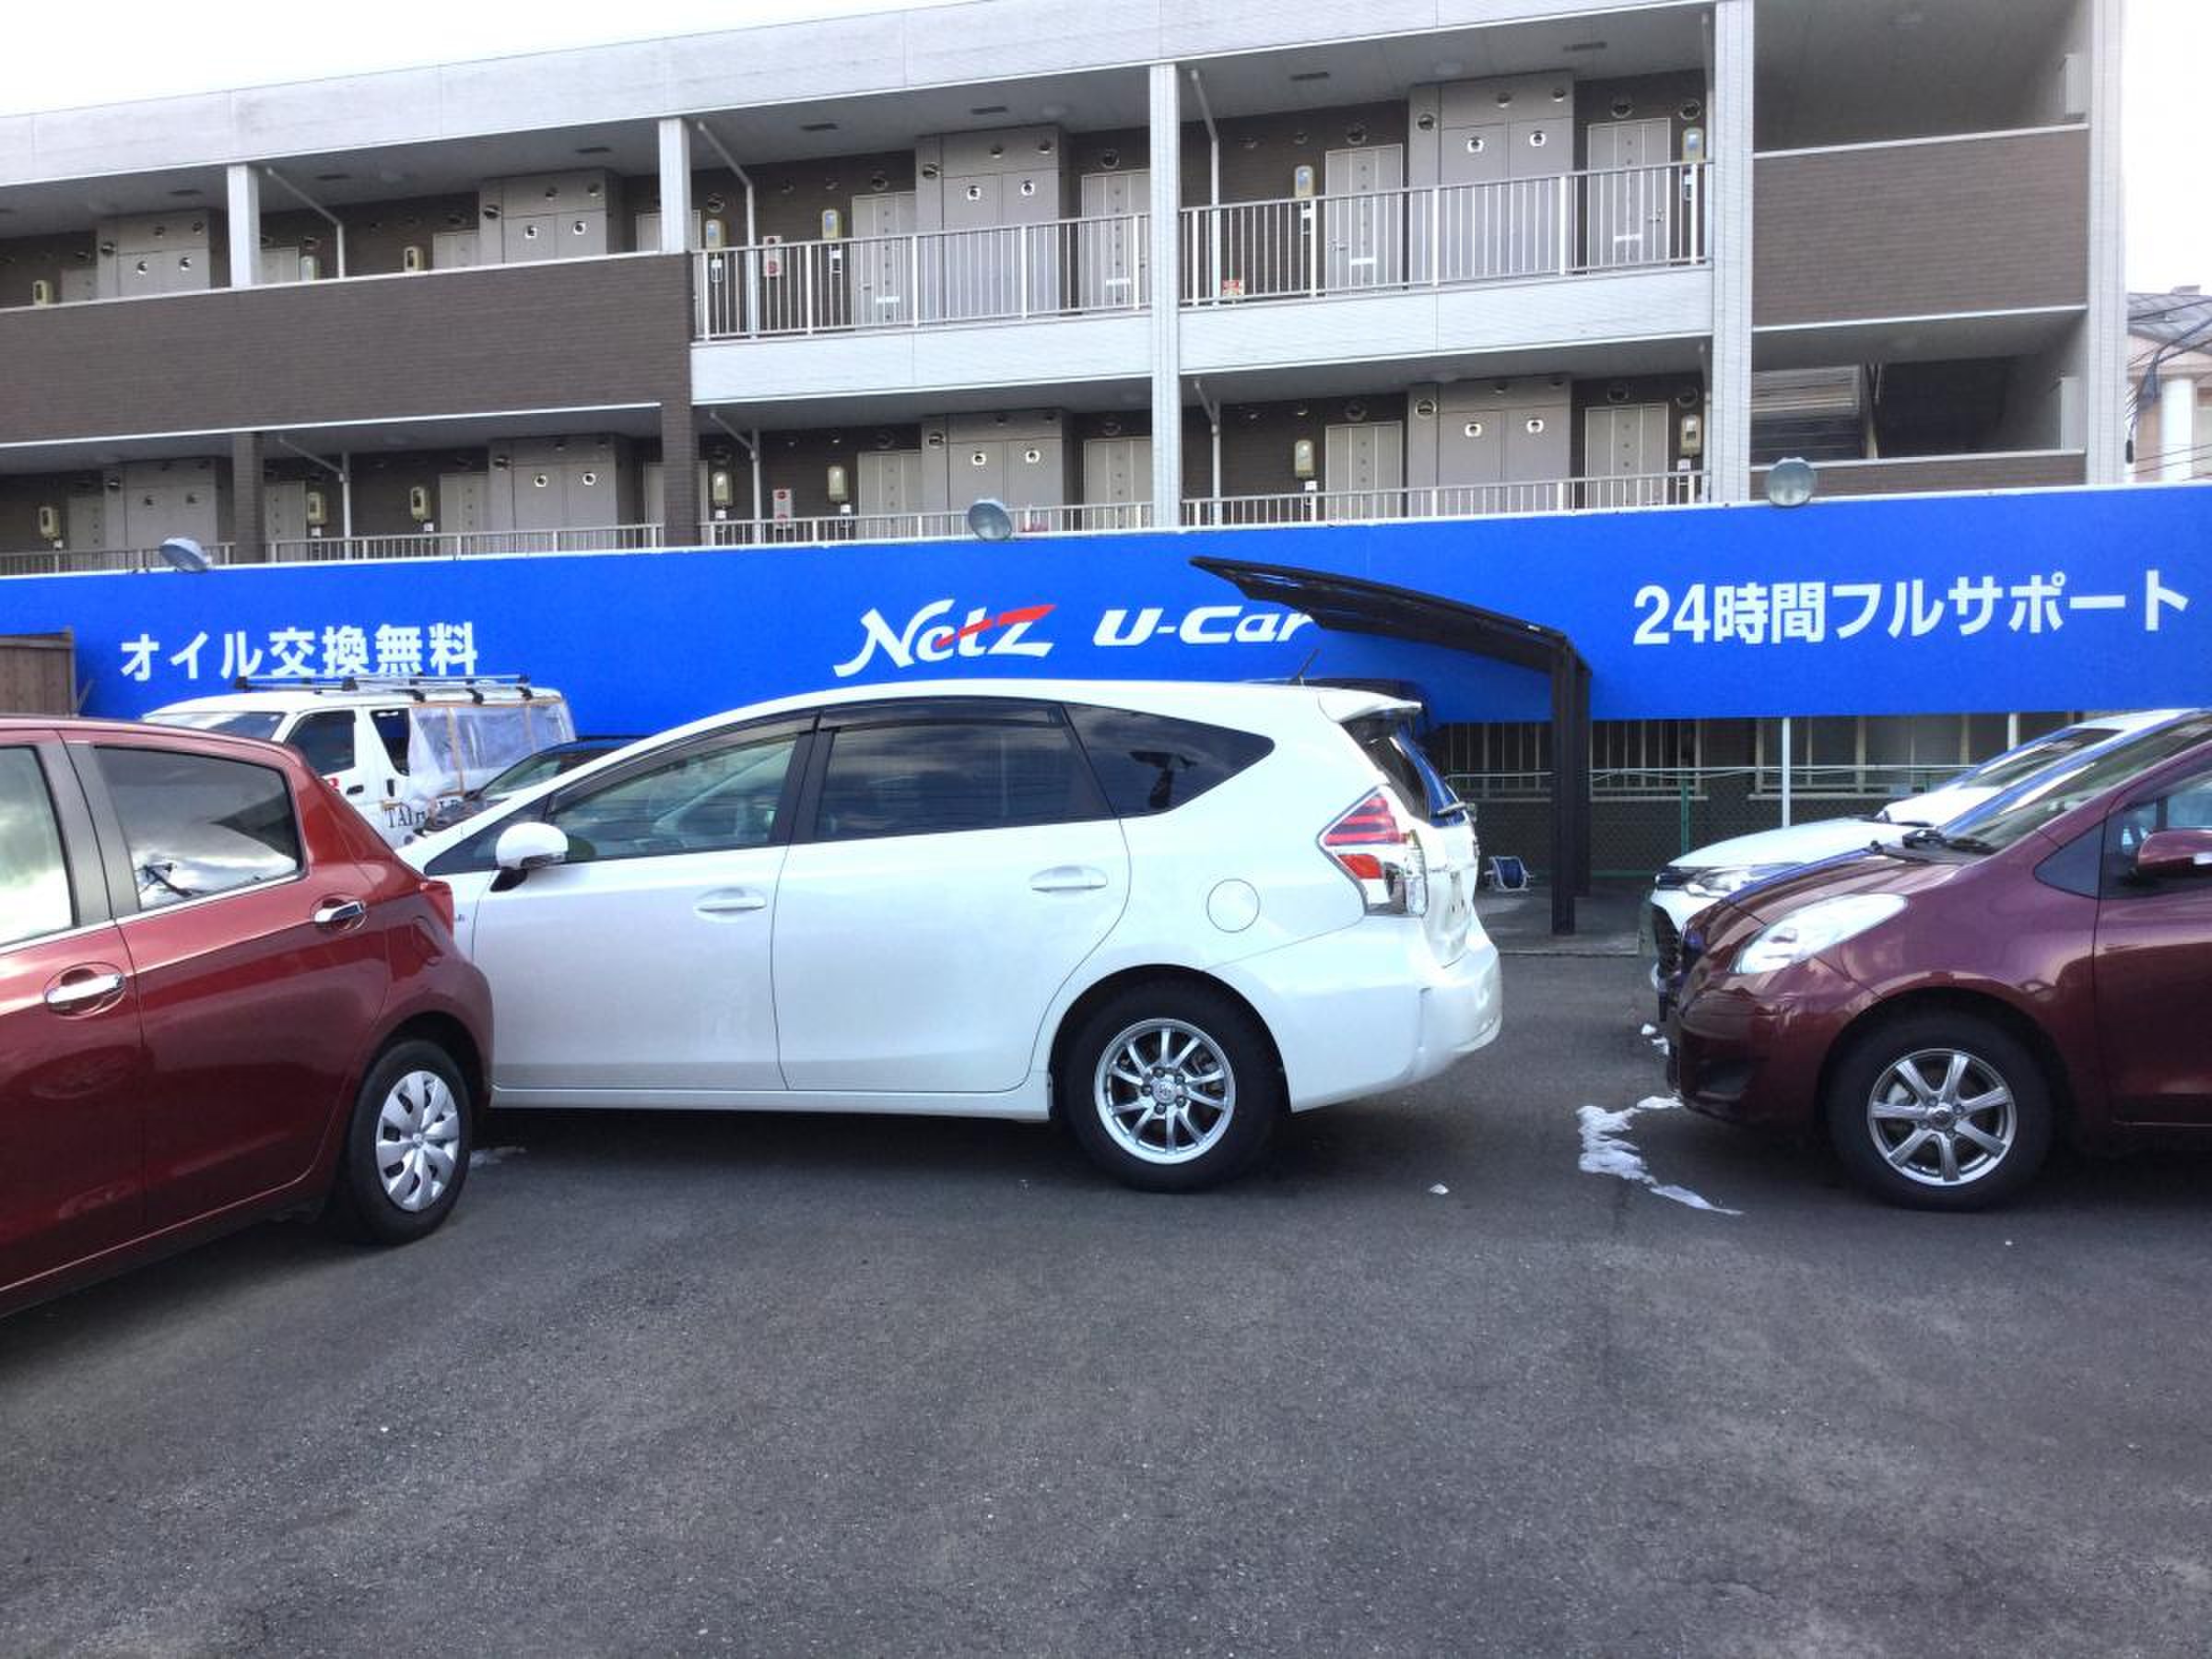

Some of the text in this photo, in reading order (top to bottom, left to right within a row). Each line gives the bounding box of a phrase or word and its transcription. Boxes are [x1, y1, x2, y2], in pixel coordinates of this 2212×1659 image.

[834, 599, 1313, 678] Netz U-Car
[1633, 570, 2189, 645] 24時間フルサポート
[122, 622, 478, 681] オイル交換無料
